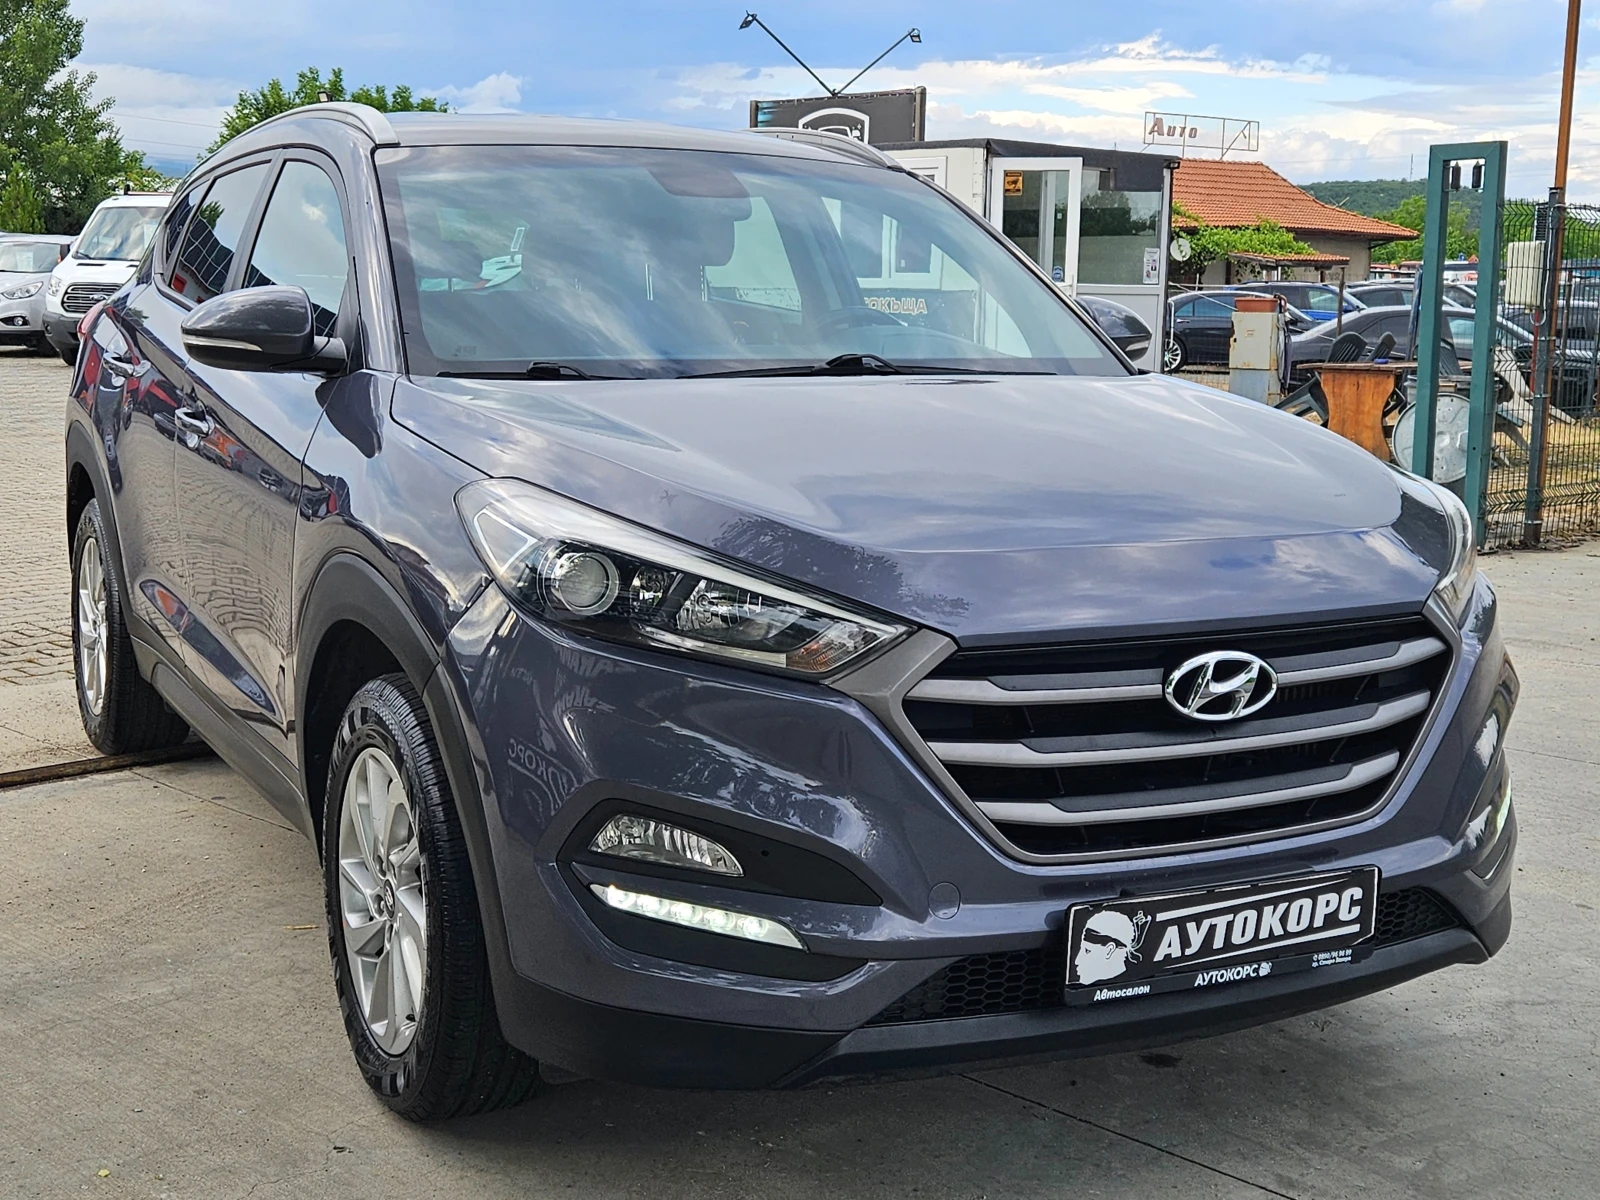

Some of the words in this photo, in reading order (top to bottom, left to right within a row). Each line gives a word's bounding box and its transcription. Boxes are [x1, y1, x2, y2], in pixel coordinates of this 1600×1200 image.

[1153, 886, 1363, 962] АУТОКОРС
[1194, 964, 1259, 987] АУТОКОРС
[1093, 984, 1151, 1002] Автосалон
